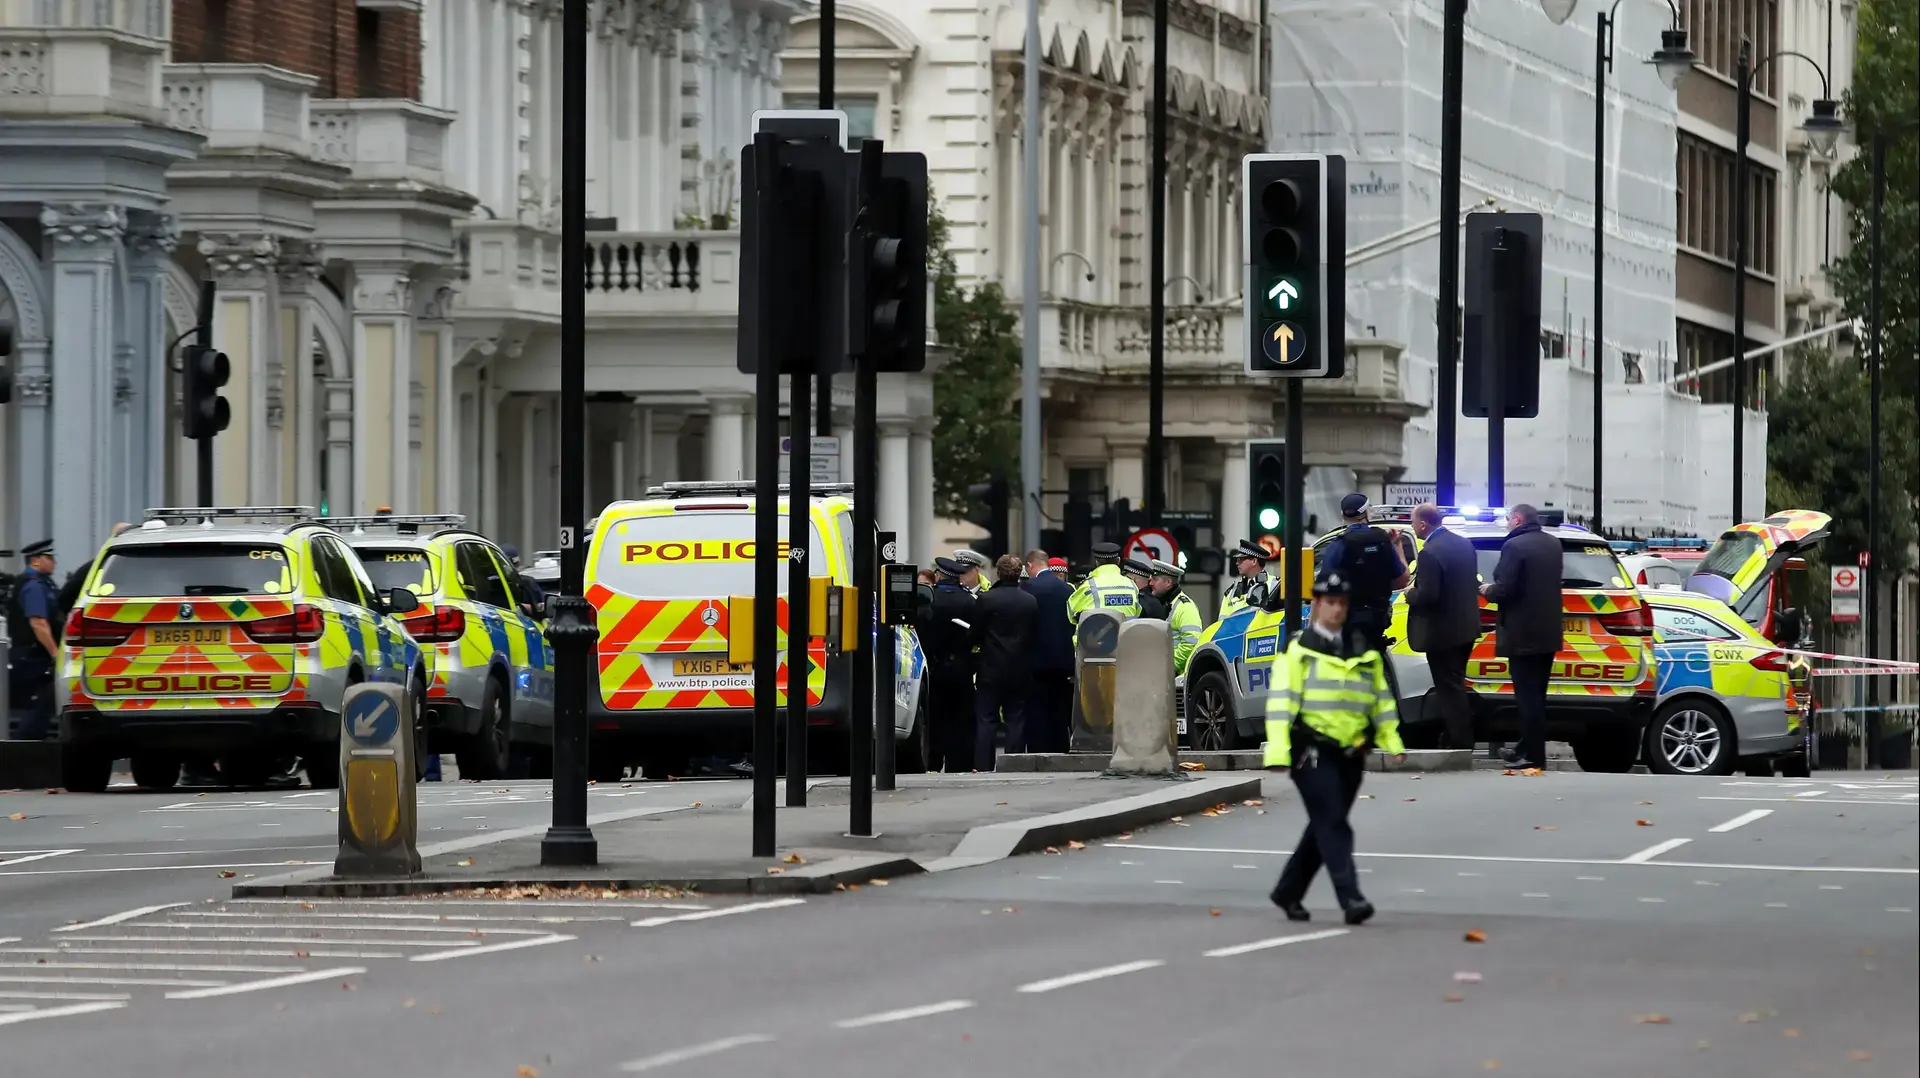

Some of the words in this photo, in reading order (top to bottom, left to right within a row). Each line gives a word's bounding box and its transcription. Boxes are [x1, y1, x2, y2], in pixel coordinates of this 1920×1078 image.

[560, 529, 570, 546] 3
[249, 550, 284, 561] CFG
[385, 553, 422, 562] HXW
[1673, 617, 1696, 625] DOG
[153, 628, 191, 644] BX65
[1665, 628, 1708, 636] SECTION
[1258, 645, 1273, 653] POLICE
[1713, 649, 1744, 660] CWX
[680, 659, 712, 674] YX16
[1479, 662, 1625, 680] PICE
[105, 675, 272, 693] POLICE
